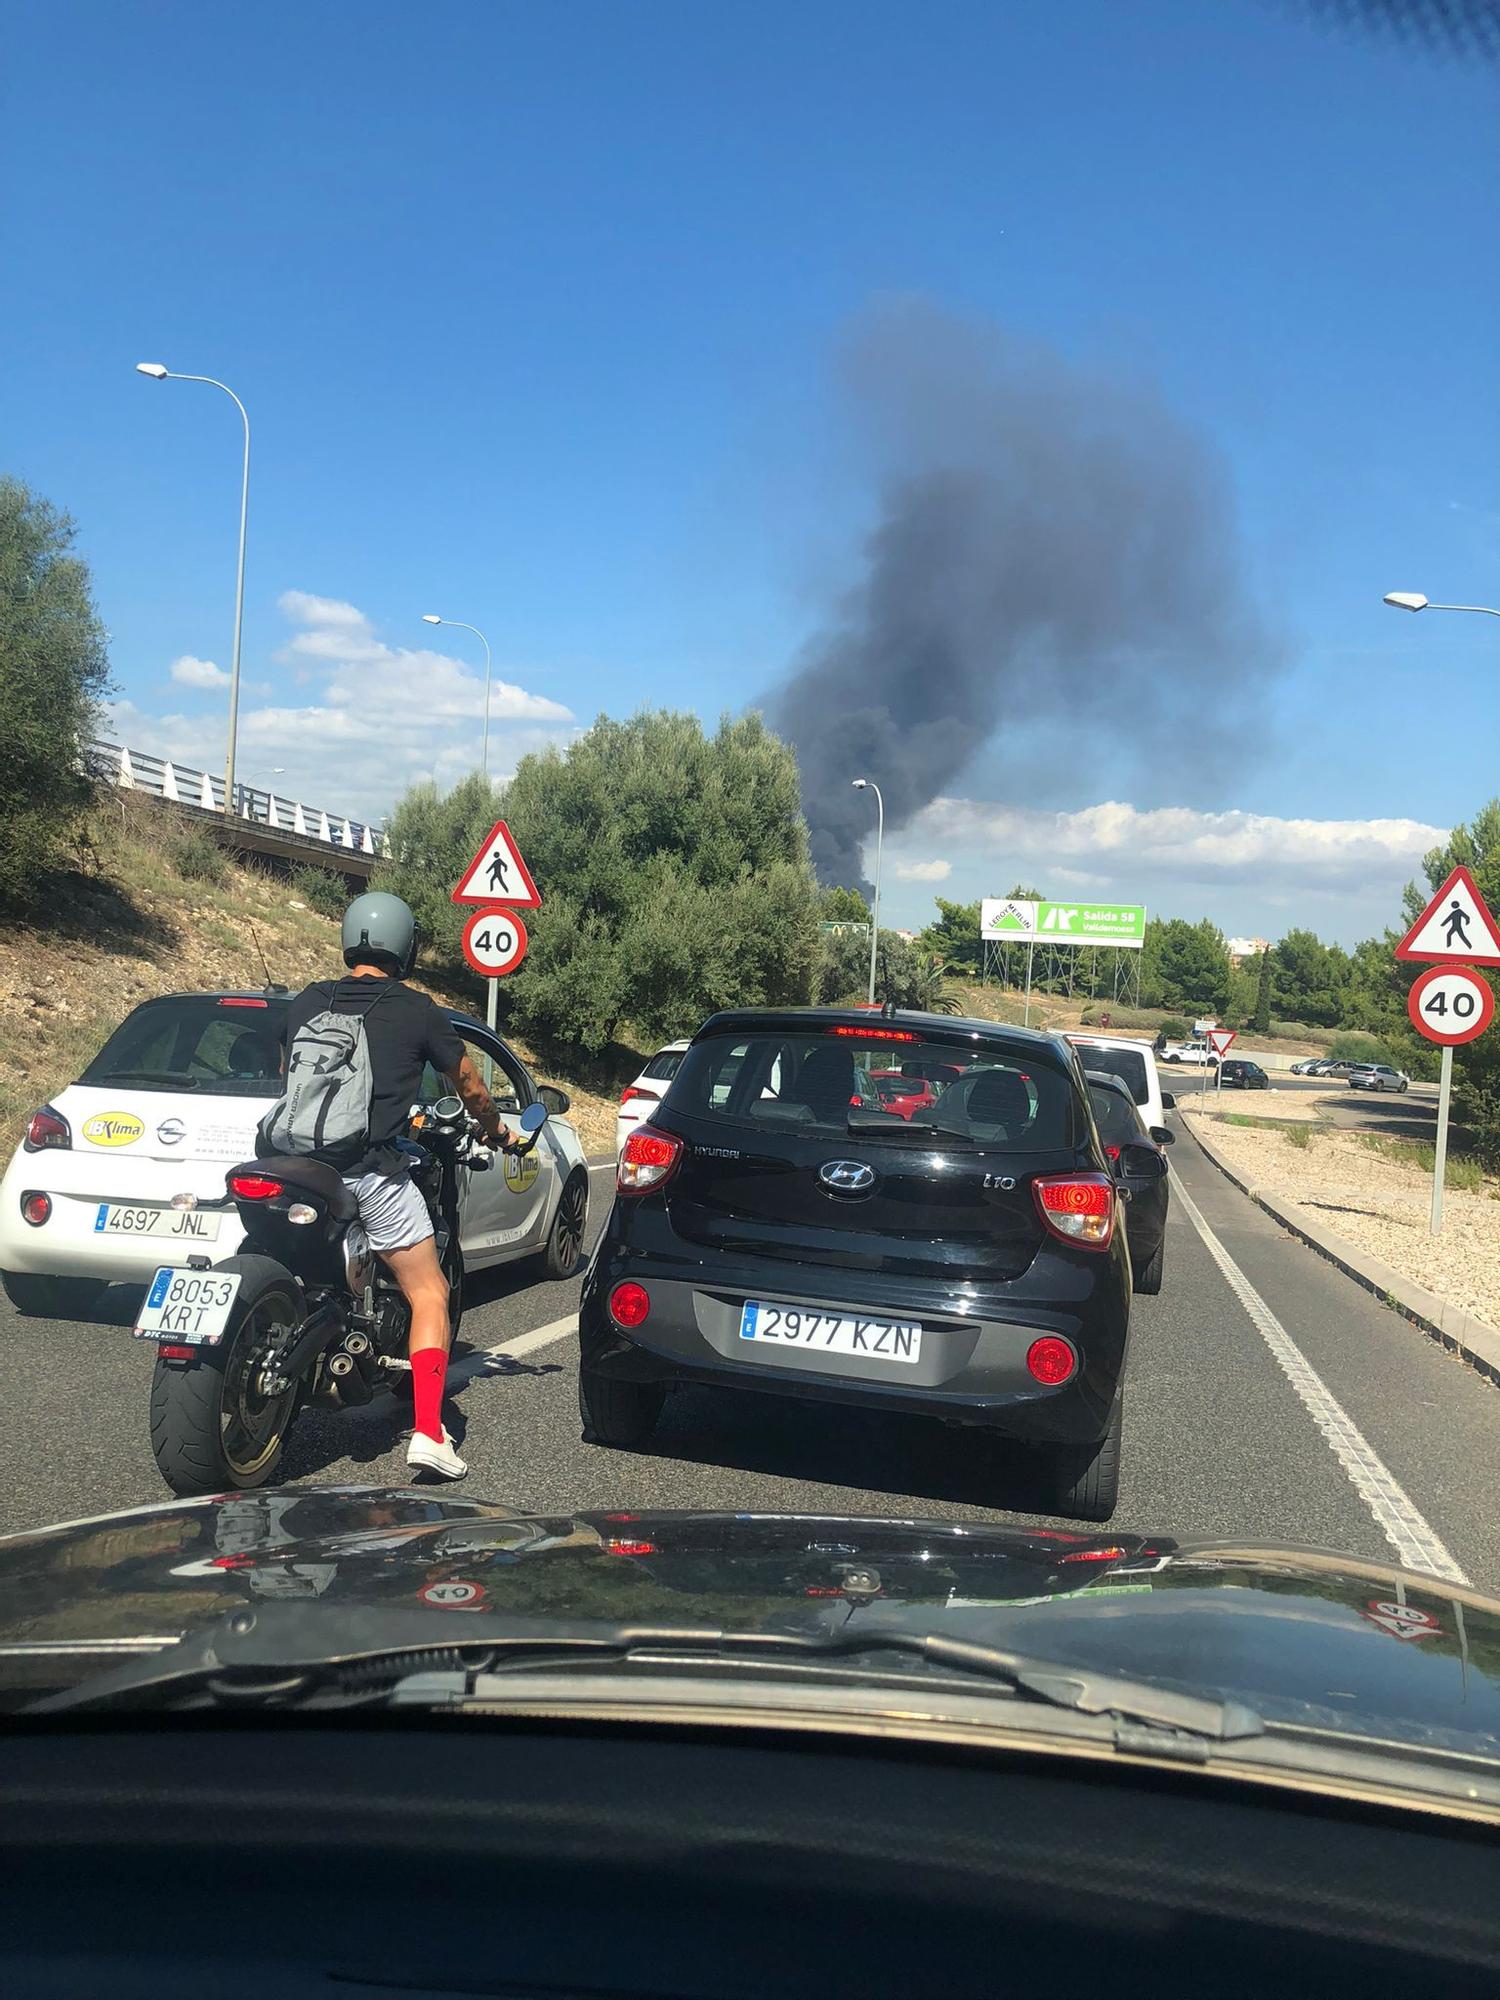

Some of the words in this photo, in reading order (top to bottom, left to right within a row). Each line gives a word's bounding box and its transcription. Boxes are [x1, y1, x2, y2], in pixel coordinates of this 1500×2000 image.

[988, 907, 1009, 928] LEROY
[1007, 903, 1032, 930] MERLIN
[1083, 911, 1118, 921] Salida
[475, 930, 512, 953] 40
[1424, 991, 1475, 1018] 40
[290, 1082, 303, 1112] UNDER
[286, 1113, 297, 1149] ARMOUR
[694, 1145, 740, 1159] HYUNDAI
[983, 1173, 1016, 1190] i10
[109, 1208, 161, 1231] 4697
[172, 1213, 208, 1235] JNL
[170, 1278, 232, 1306] 8053
[159, 1304, 209, 1331] KRT
[763, 1308, 842, 1345] 2977
[852, 1320, 913, 1356] KZN
